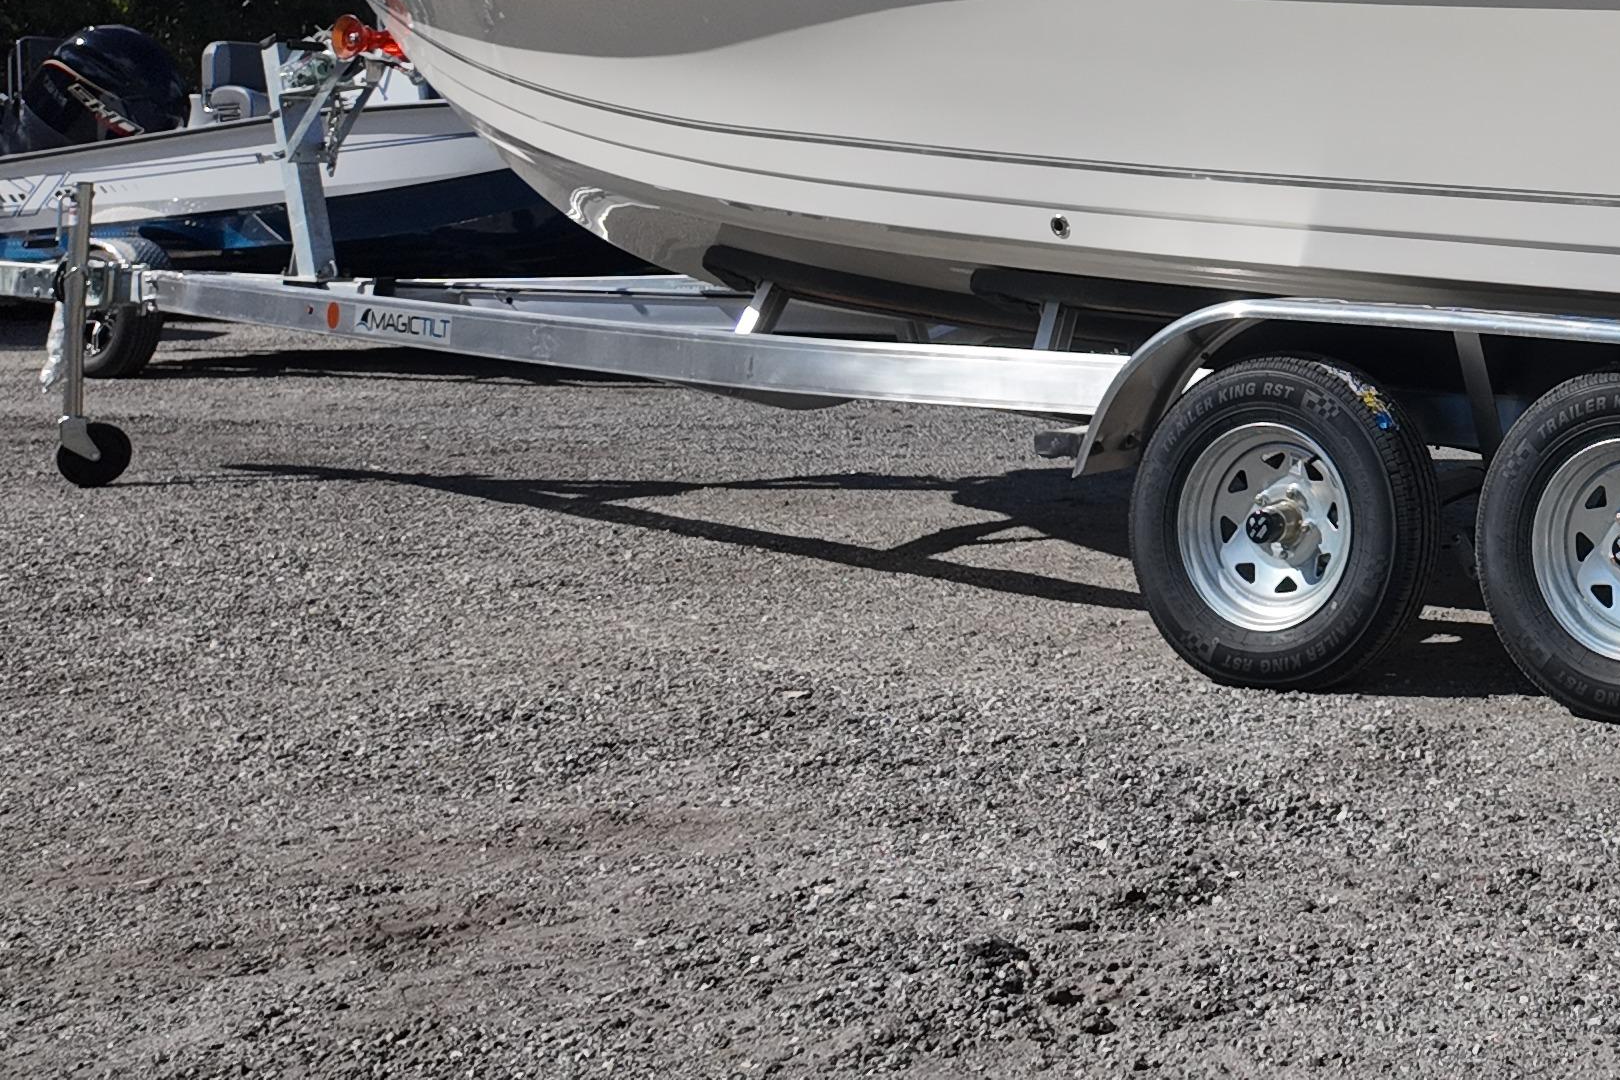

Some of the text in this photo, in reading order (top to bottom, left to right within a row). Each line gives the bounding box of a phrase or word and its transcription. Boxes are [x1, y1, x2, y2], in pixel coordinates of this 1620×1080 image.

[371, 311, 450, 338] MAGICTILT
[1161, 381, 1295, 453] TRAILER KING RST
[1537, 396, 1607, 440] TRAILER
[1305, 602, 1364, 662] TRAILER
[1259, 652, 1302, 674] KING
